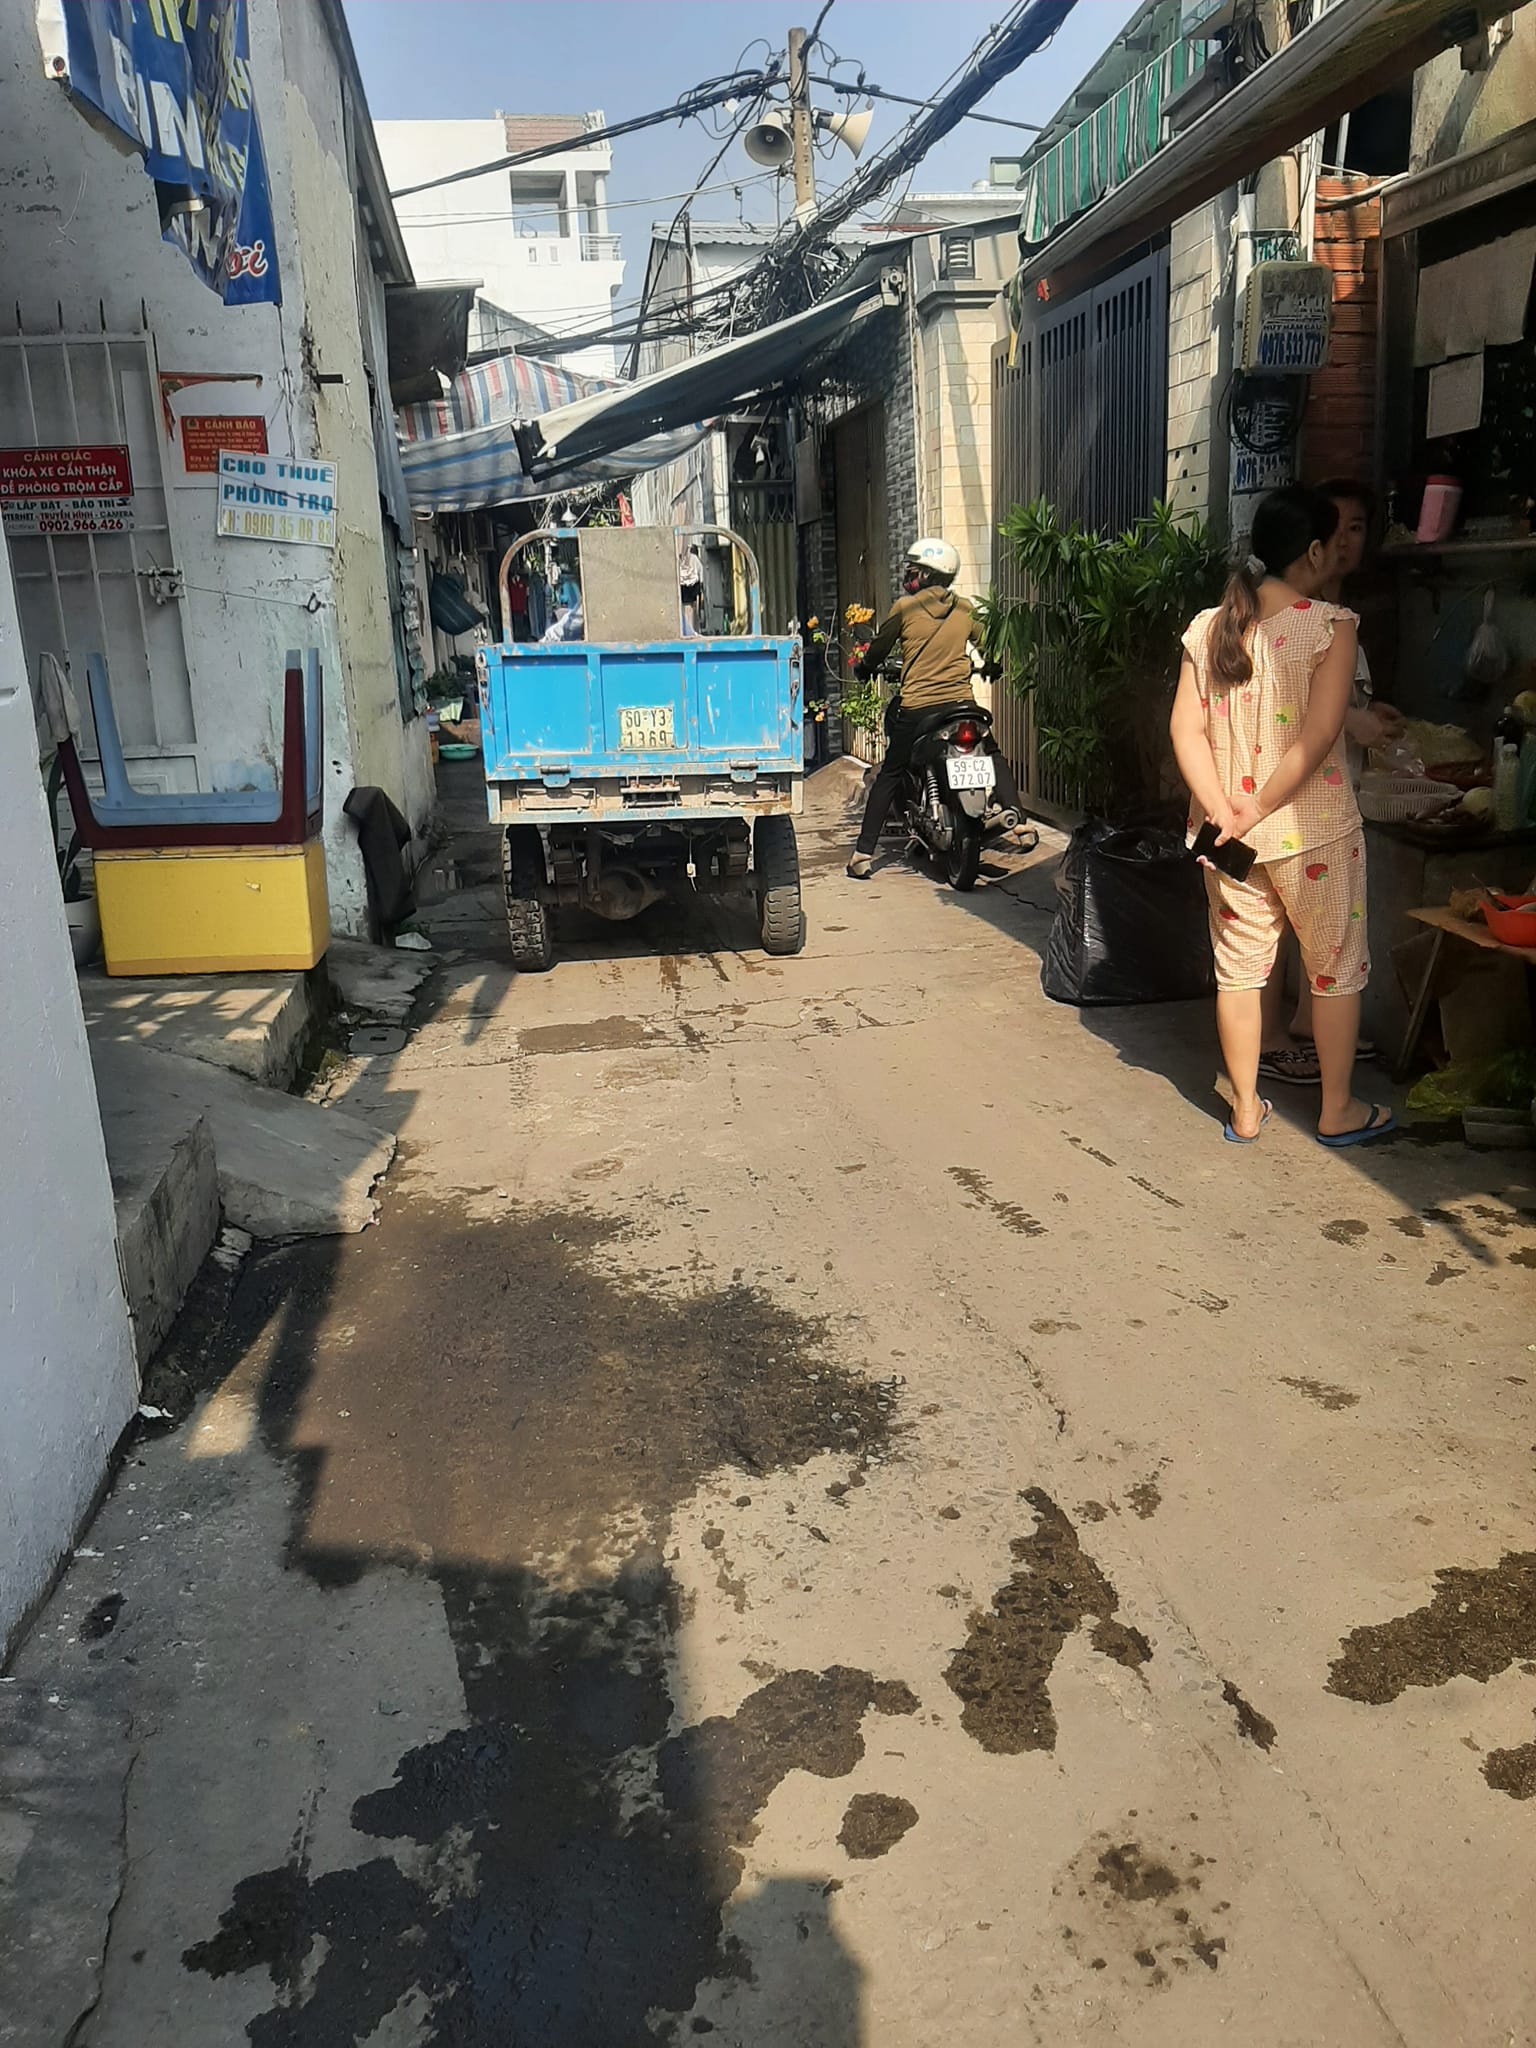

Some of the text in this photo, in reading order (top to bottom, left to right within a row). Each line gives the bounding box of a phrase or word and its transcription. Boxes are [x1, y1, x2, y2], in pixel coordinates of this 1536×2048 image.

[3, 465, 37, 478] KHÓA
[40, 466, 54, 477] XE
[85, 463, 116, 479] THẬN
[224, 458, 334, 483] CHO THUÊ
[18, 481, 60, 493] PHÒNG
[63, 480, 95, 496] TRỘM
[297, 493, 333, 515] TRỌ
[100, 510, 134, 518] CAMERA
[40, 518, 123, 531] 0902.966.426
[627, 730, 667, 747] 1369
[953, 760, 986, 773] 59-C2
